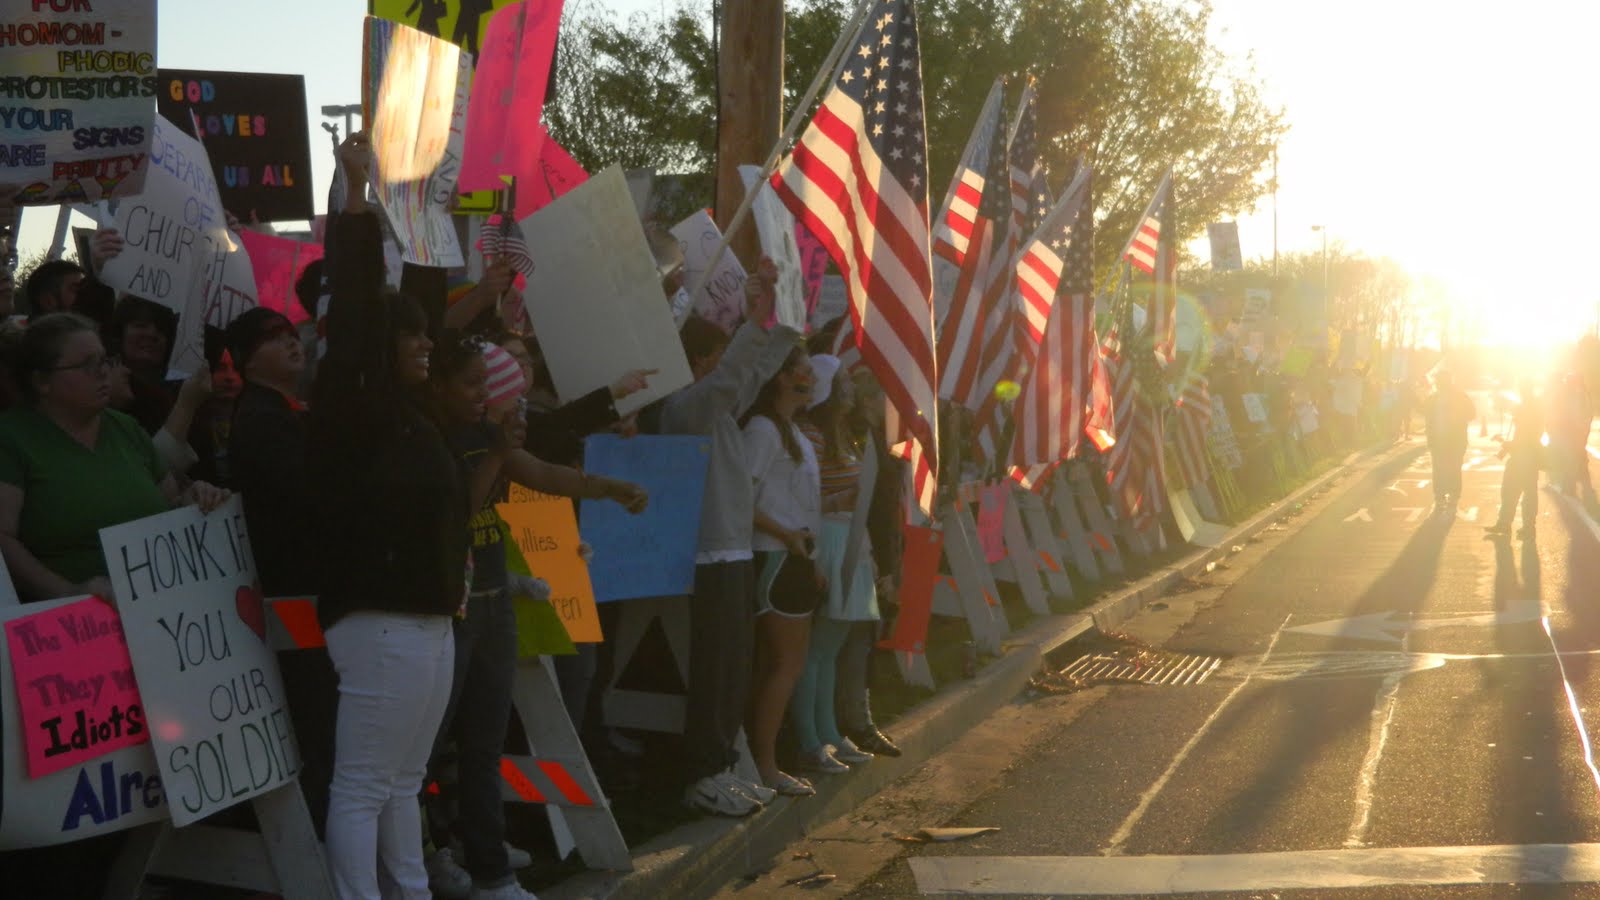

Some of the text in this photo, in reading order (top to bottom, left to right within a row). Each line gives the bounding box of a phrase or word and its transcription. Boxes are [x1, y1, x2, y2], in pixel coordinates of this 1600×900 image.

[57, 50, 154, 74] PHOBIC
[170, 79, 216, 103] GOD
[0, 107, 74, 131] YOUR
[191, 114, 267, 138] LOVES
[0, 144, 46, 167] ARE
[73, 126, 144, 150] SIGNS
[262, 163, 295, 188] ALL
[184, 196, 215, 231] OF
[128, 264, 172, 299] AND
[120, 514, 250, 601] HONK IF
[13, 620, 62, 657] The
[157, 609, 232, 672] YOU
[30, 671, 106, 709] They
[209, 667, 274, 723] OUR
[40, 703, 142, 757] Idiots
[169, 706, 298, 815] SOLDIE
[61, 759, 167, 832] Alre
